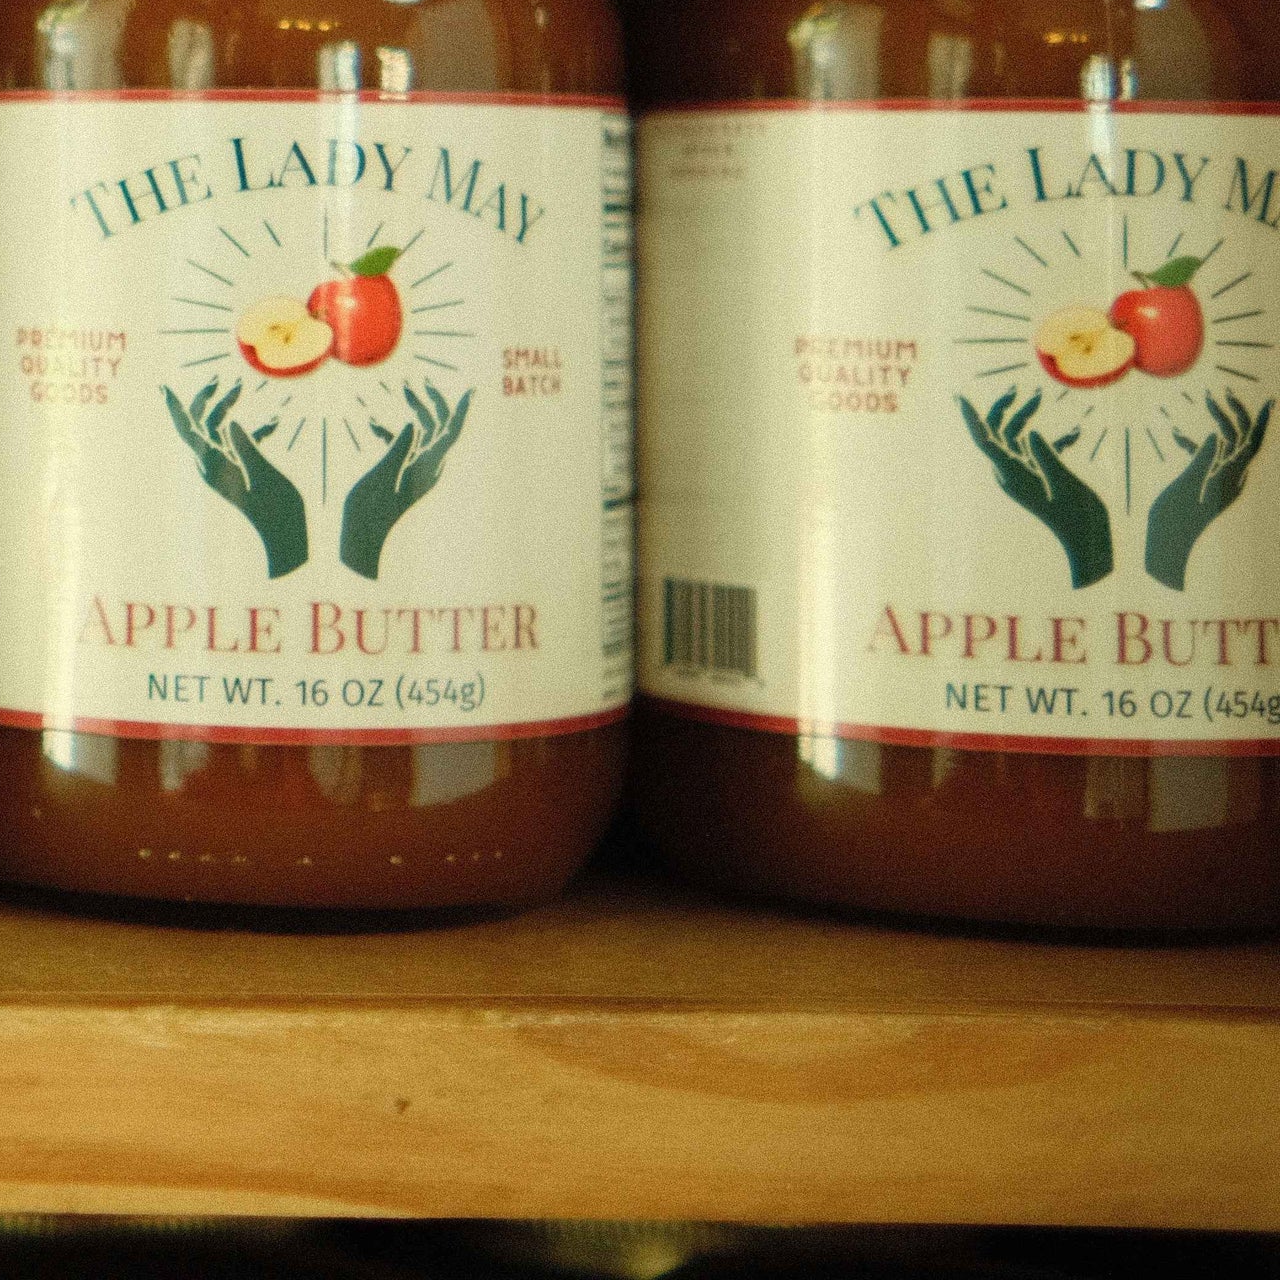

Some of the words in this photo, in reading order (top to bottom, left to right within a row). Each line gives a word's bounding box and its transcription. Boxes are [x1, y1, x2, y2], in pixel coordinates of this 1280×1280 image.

[69, 156, 212, 240] THE
[230, 137, 414, 192] LADY
[426, 147, 546, 244] MAY
[853, 163, 1008, 250] THE
[1026, 146, 1210, 203] LADY
[1224, 156, 1280, 230] M
[502, 349, 563, 370] SMALL
[502, 376, 562, 397] BATCH
[76, 595, 282, 651] APPLE
[309, 600, 540, 655] BUTTER
[865, 605, 1088, 664] APPLE
[147, 673, 210, 704] NET
[222, 674, 281, 707] WT.
[294, 677, 329, 707] 16
[341, 677, 383, 707] OZ
[395, 672, 487, 710] (454g)
[946, 683, 1012, 715] NET
[1025, 686, 1087, 717] WT.
[1103, 690, 1137, 717] 16
[1150, 690, 1192, 718] OZ
